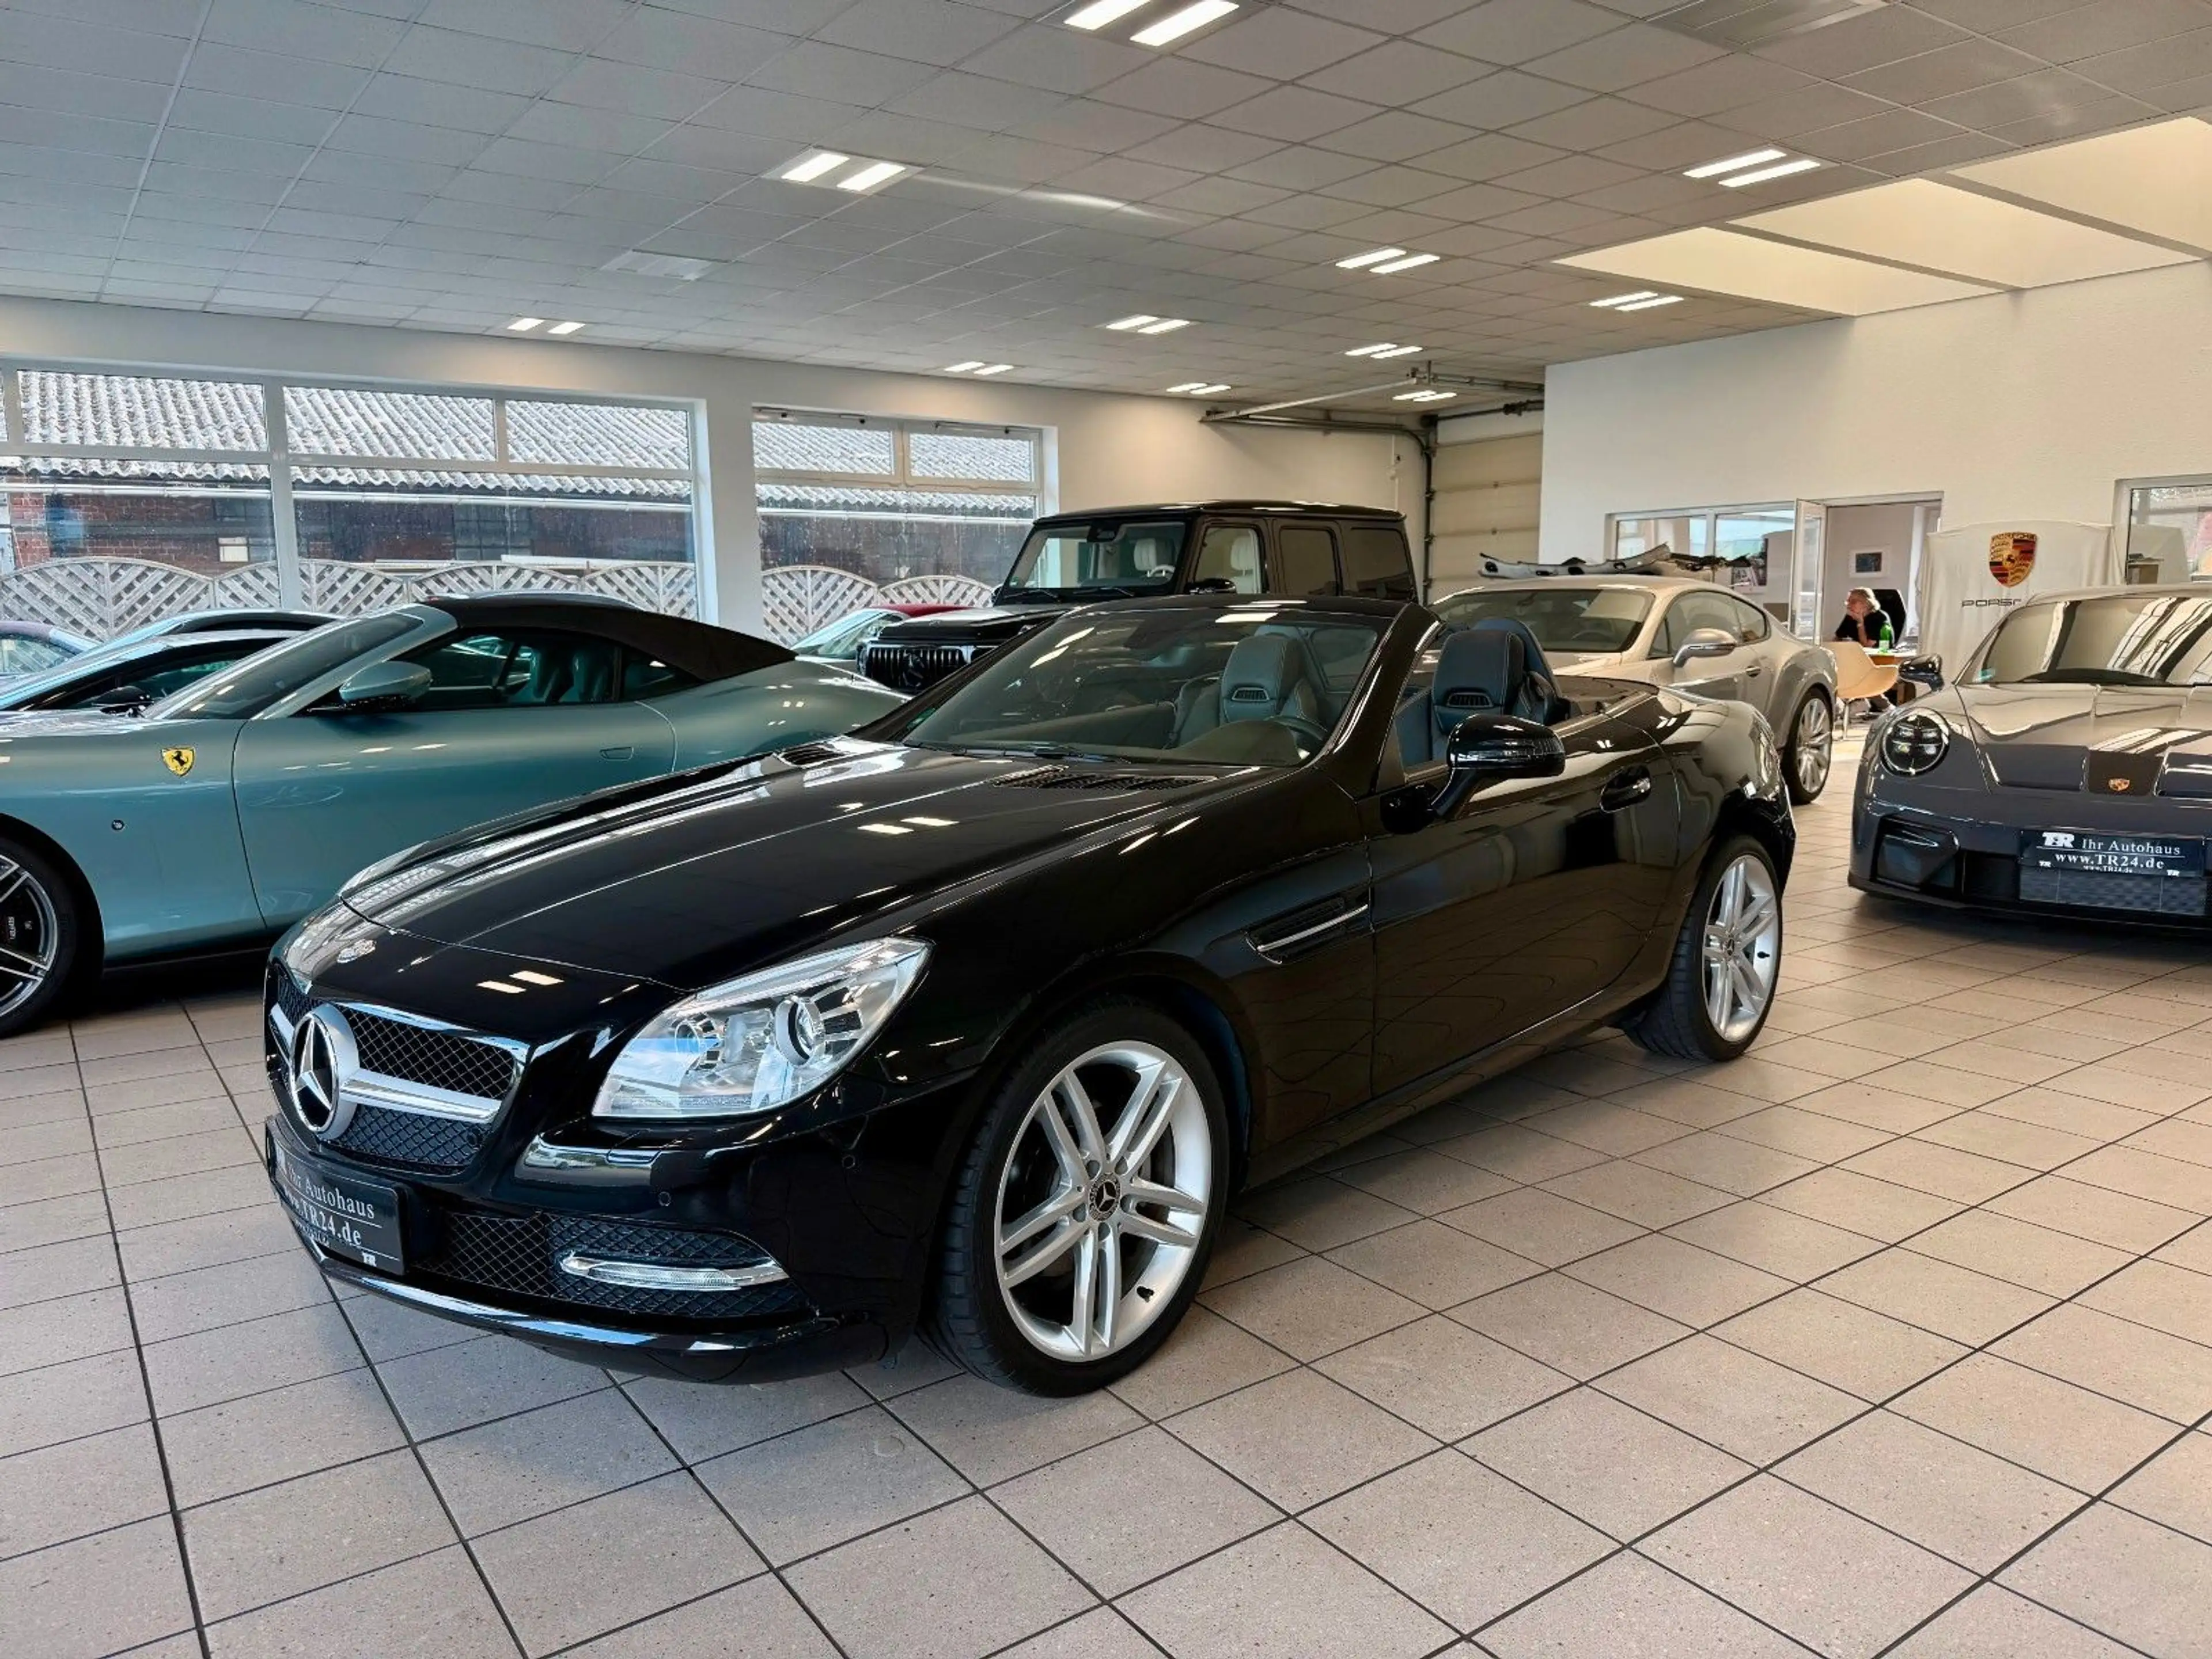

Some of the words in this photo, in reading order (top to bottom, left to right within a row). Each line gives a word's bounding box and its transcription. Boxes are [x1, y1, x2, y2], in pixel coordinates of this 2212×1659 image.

[2082, 838, 2104, 850] Ihr
[2108, 840, 2180, 855] Autohaus
[2055, 854, 2165, 869] www.TR24.de
[305, 1179, 374, 1219] Autohaus
